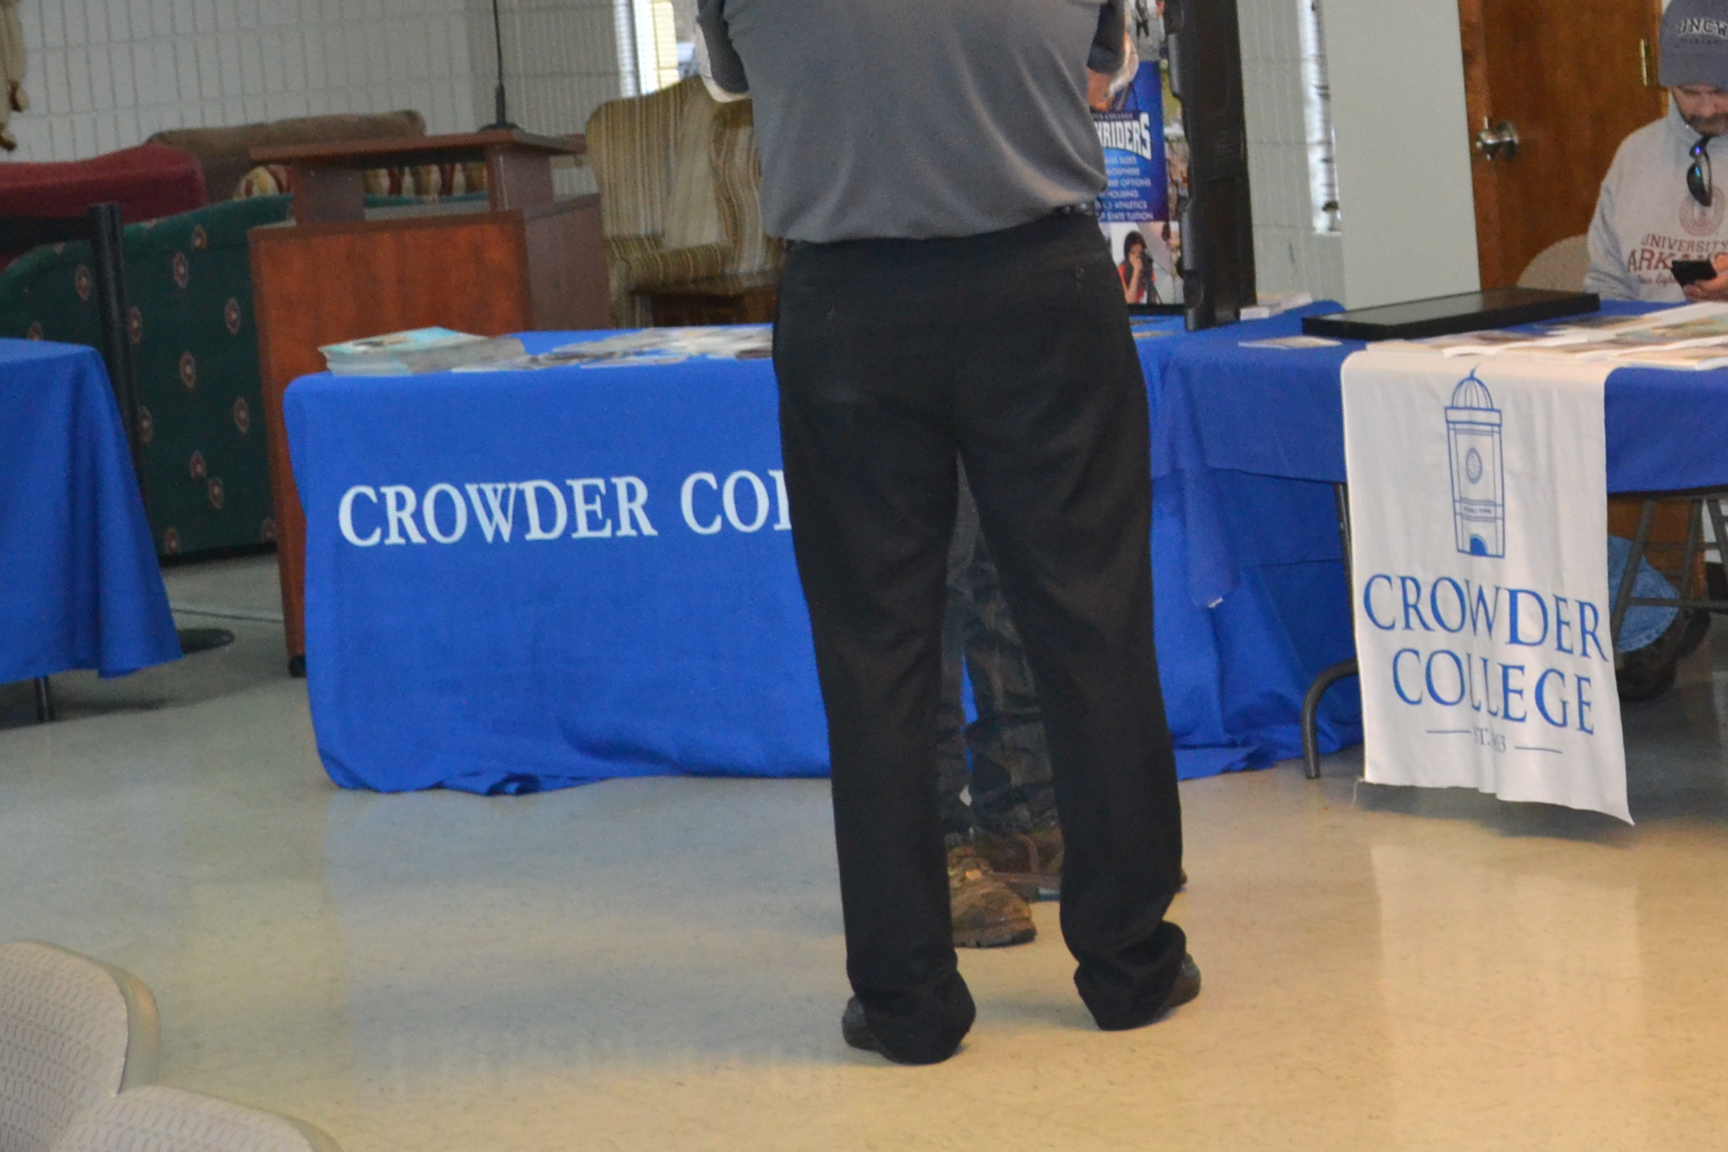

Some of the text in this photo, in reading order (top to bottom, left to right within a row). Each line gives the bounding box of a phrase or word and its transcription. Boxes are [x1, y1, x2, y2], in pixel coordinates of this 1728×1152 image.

[338, 475, 658, 547] CROWDER
[1363, 573, 1608, 663] CROWDER
[1392, 648, 1595, 735] COLLEGE
